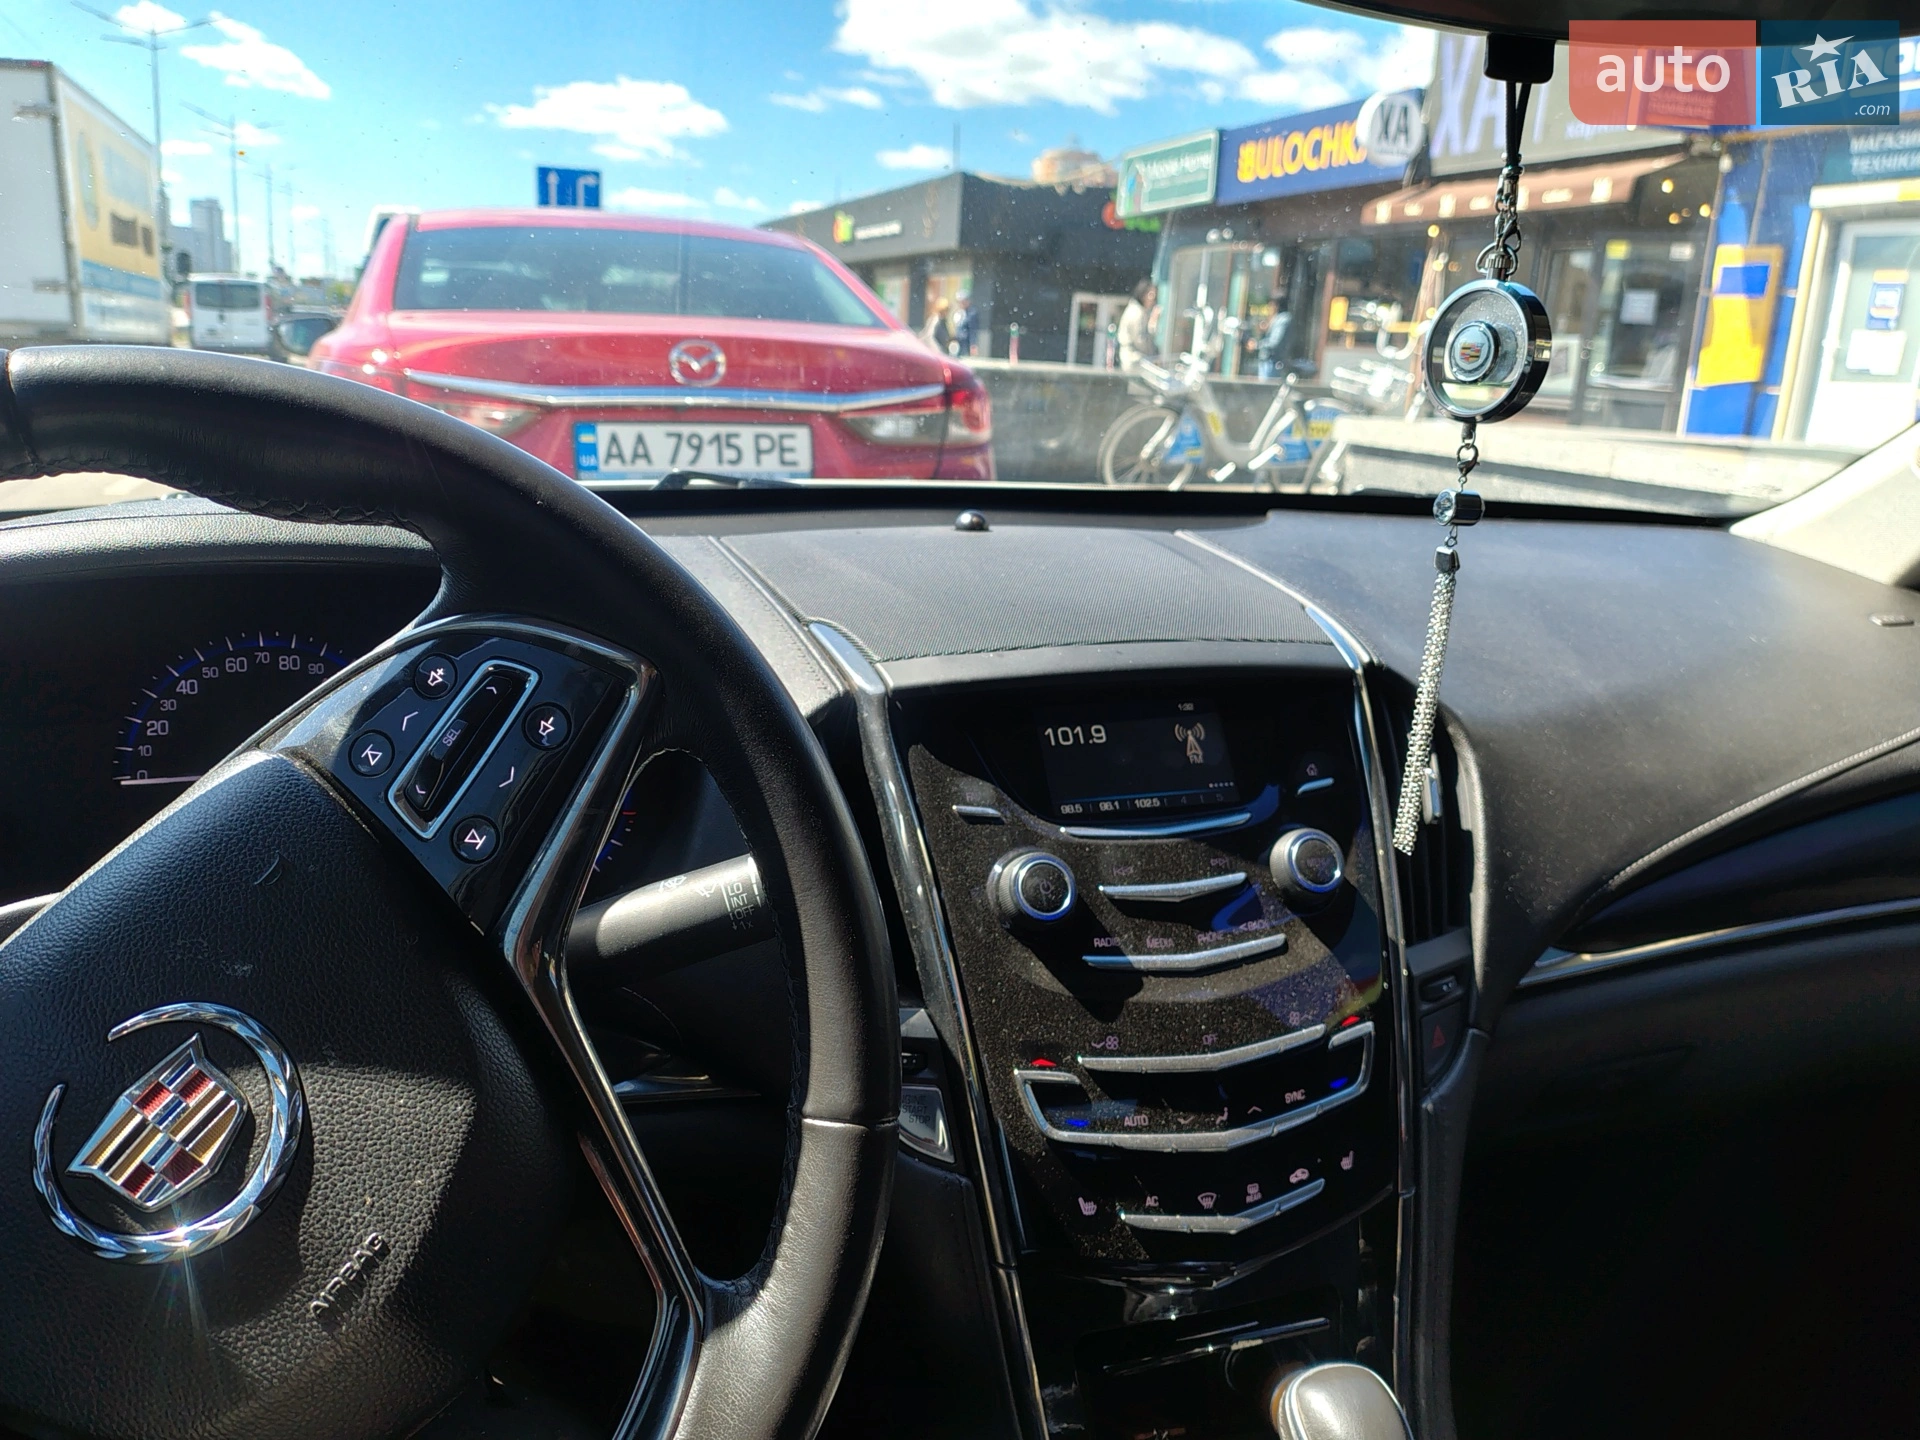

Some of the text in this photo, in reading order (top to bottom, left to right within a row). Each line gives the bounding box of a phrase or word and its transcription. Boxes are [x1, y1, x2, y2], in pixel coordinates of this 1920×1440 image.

[1237, 119, 1367, 183] BULOCHK
[603, 431, 799, 466] AA 7915 PE
[225, 656, 248, 672] 60
[254, 651, 270, 664] 70
[278, 655, 301, 670] 80
[202, 666, 219, 678] 50
[308, 662, 325, 675] 90
[175, 678, 199, 695] 40
[159, 698, 177, 711] 30
[146, 720, 169, 736] 20
[1043, 724, 1107, 746] 101.9
[441, 728, 462, 747] SEL
[137, 744, 152, 757] 10
[1188, 754, 1204, 764] FM
[727, 882, 743, 896] LO
[730, 893, 748, 909] INT
[734, 904, 755, 920] OFF
[1285, 1089, 1306, 1104] SYNC
[909, 1115, 931, 1124] STOP
[1124, 1114, 1149, 1127] AUTO
[1145, 1196, 1159, 1207] AC
